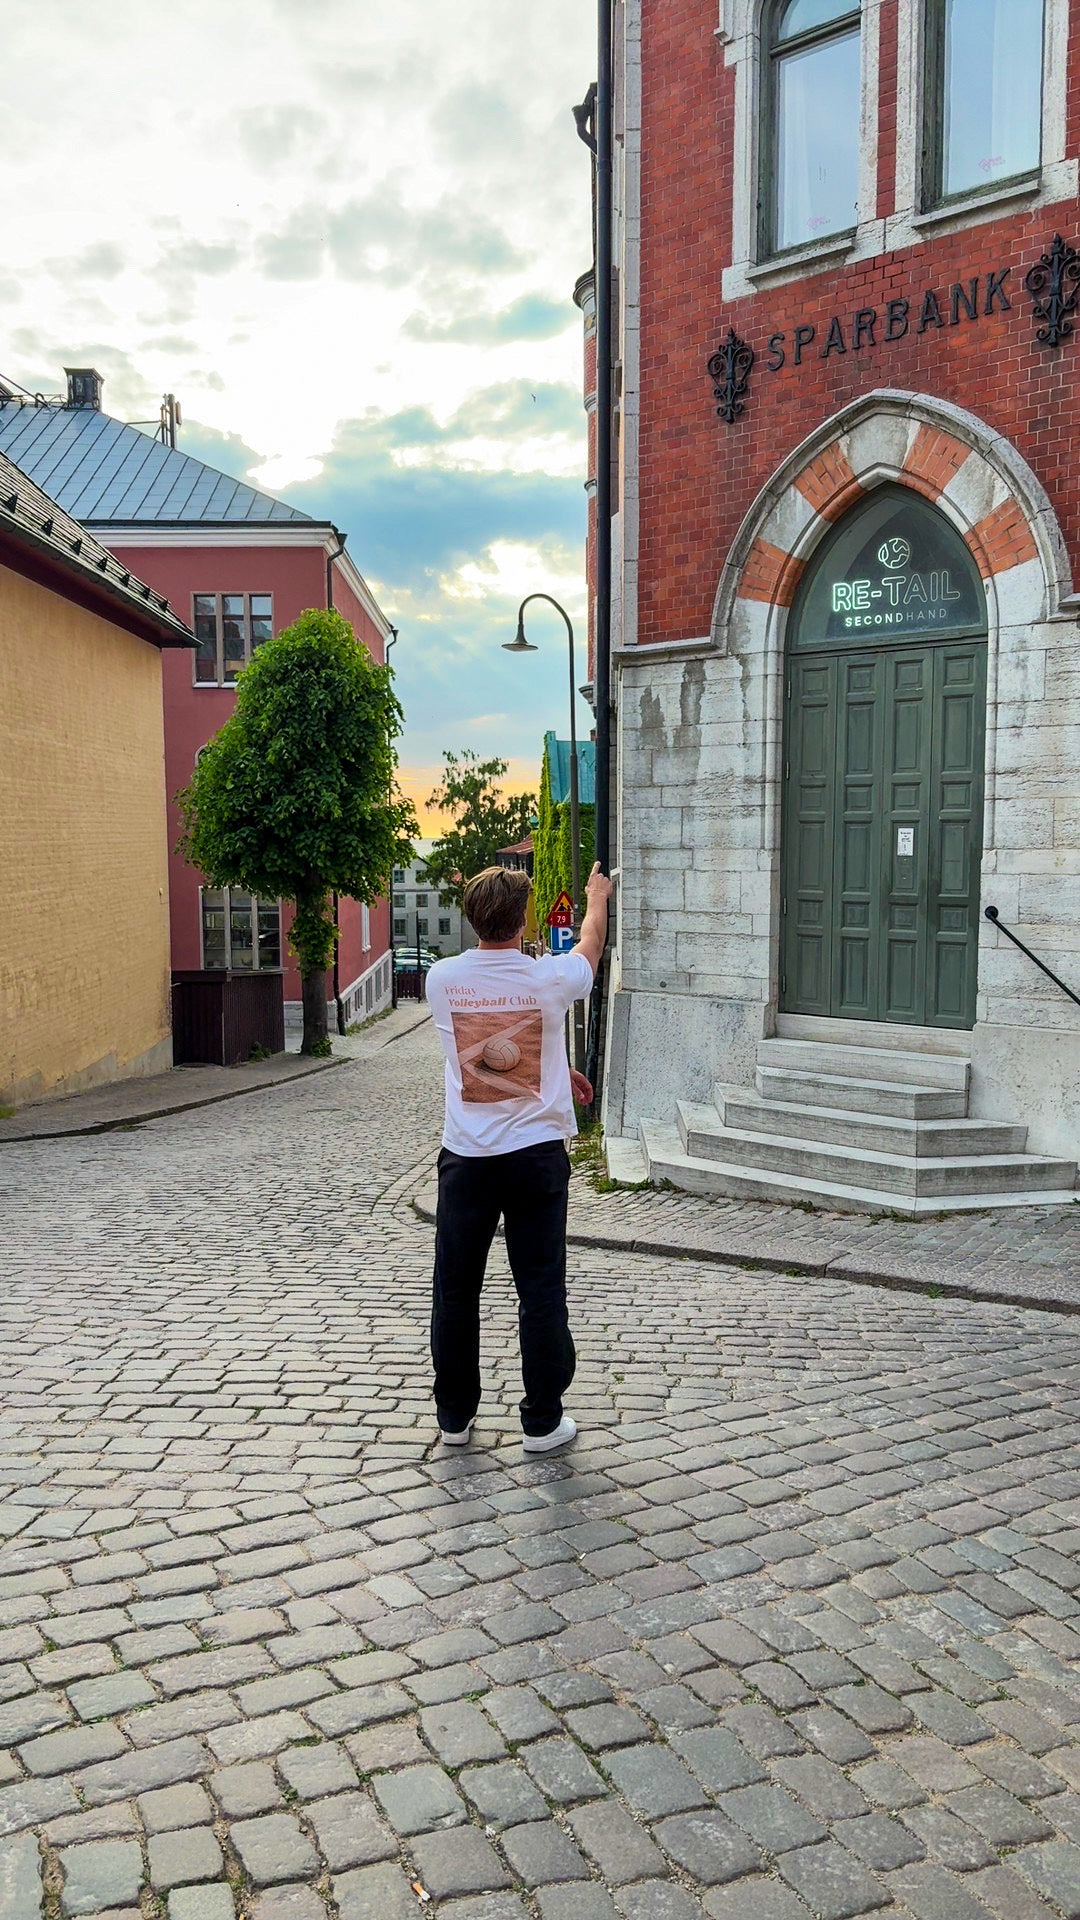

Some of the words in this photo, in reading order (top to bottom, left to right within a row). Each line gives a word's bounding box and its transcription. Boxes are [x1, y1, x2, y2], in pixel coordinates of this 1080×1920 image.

[766, 268, 1012, 372] SPARBANK
[832, 570, 961, 612] RE-TAIL
[845, 608, 947, 627] SECONDHAND
[558, 927, 574, 949] P
[445, 985, 476, 997] Friday
[448, 997, 507, 1009] Volleyball
[509, 995, 537, 1006] Club
